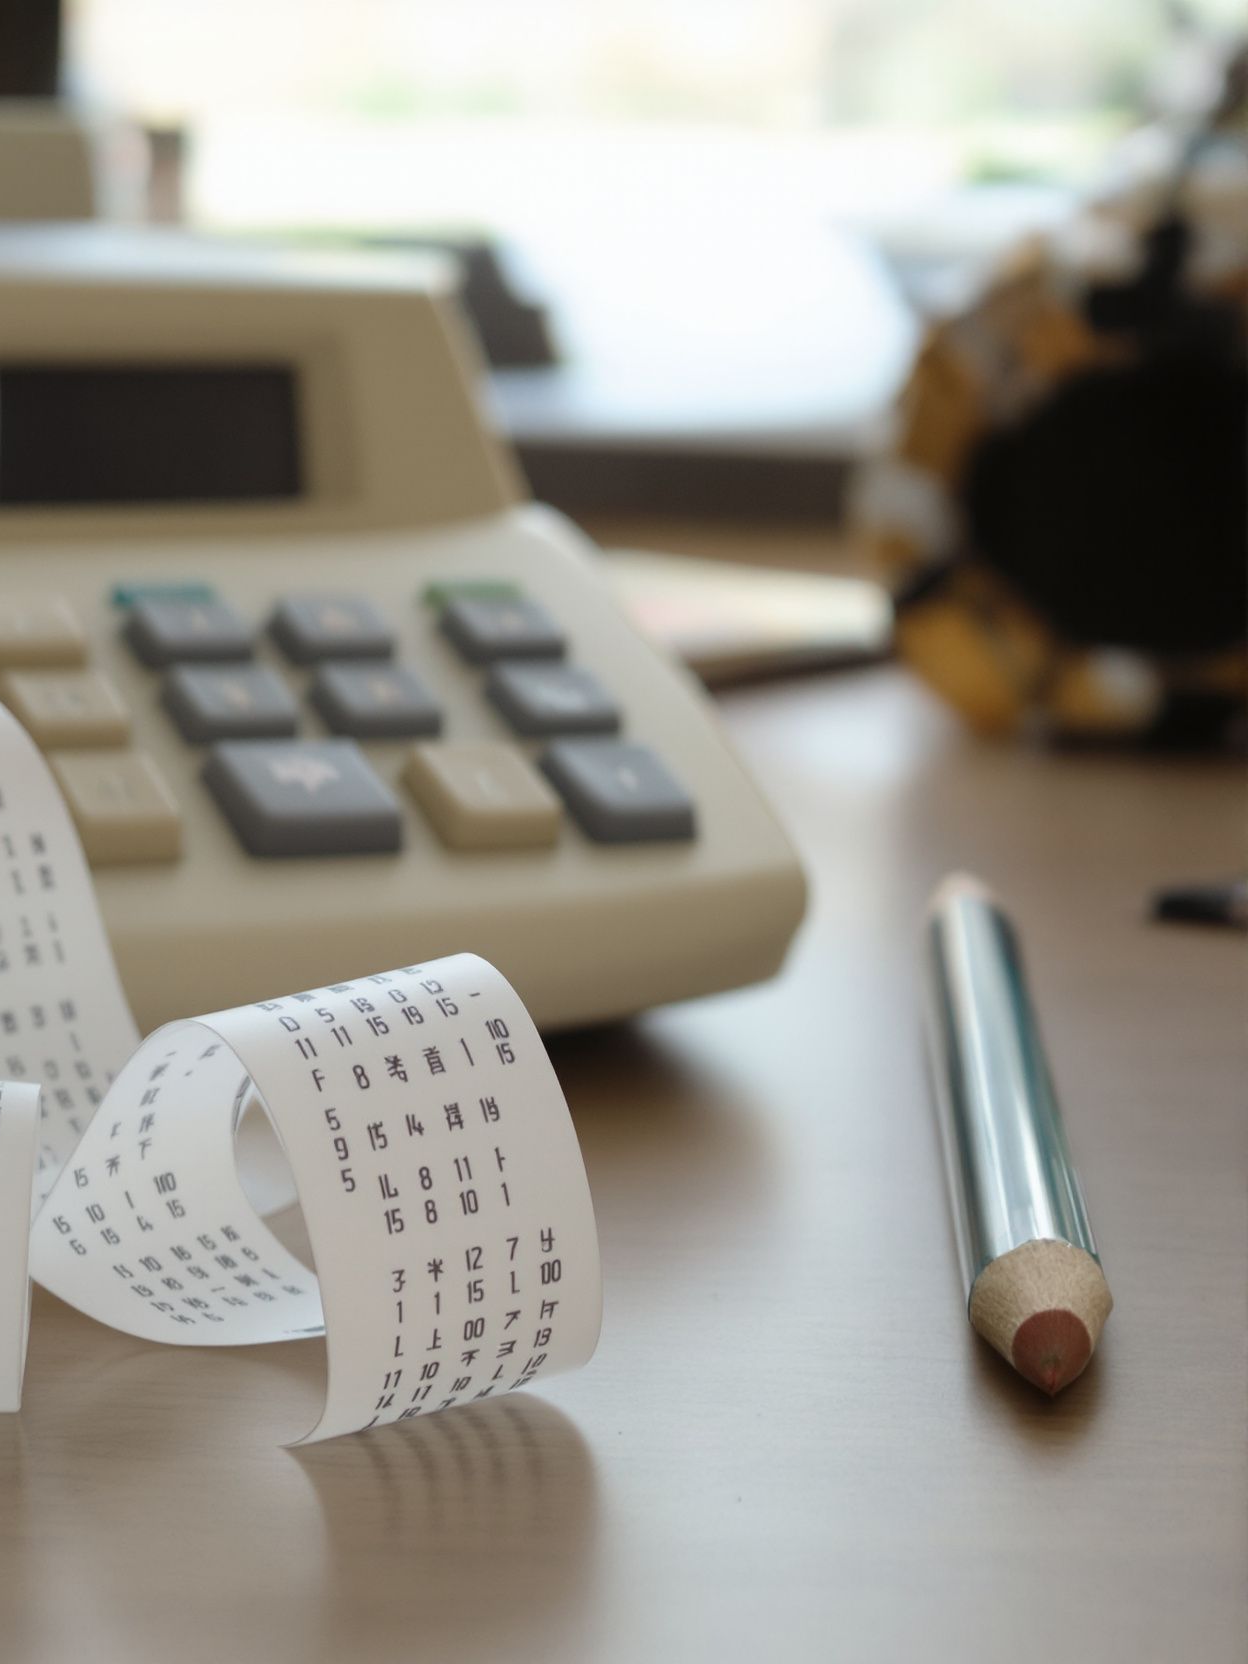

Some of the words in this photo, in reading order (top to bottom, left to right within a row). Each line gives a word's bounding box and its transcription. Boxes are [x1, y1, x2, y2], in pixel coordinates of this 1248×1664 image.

[295, 1038, 317, 1059] 11
[331, 1026, 352, 1047] 11
[366, 1016, 389, 1036] 15
[436, 998, 458, 1017] 15
[312, 1069, 324, 1092] F
[353, 1065, 370, 1089] 8
[496, 1043, 515, 1065] 15
[325, 1108, 341, 1131] 5
[334, 1137, 348, 1161] 9
[341, 1168, 355, 1192] 5
[419, 1167, 432, 1190] 8
[454, 1156, 472, 1182] 11
[384, 1208, 404, 1234] 15
[425, 1200, 438, 1224] 8
[459, 1189, 478, 1215] 10
[466, 1247, 483, 1271] 12
[506, 1237, 518, 1260] 7
[467, 1279, 484, 1304] 15
[464, 1318, 485, 1341] 00
[420, 1362, 439, 1381] 10
